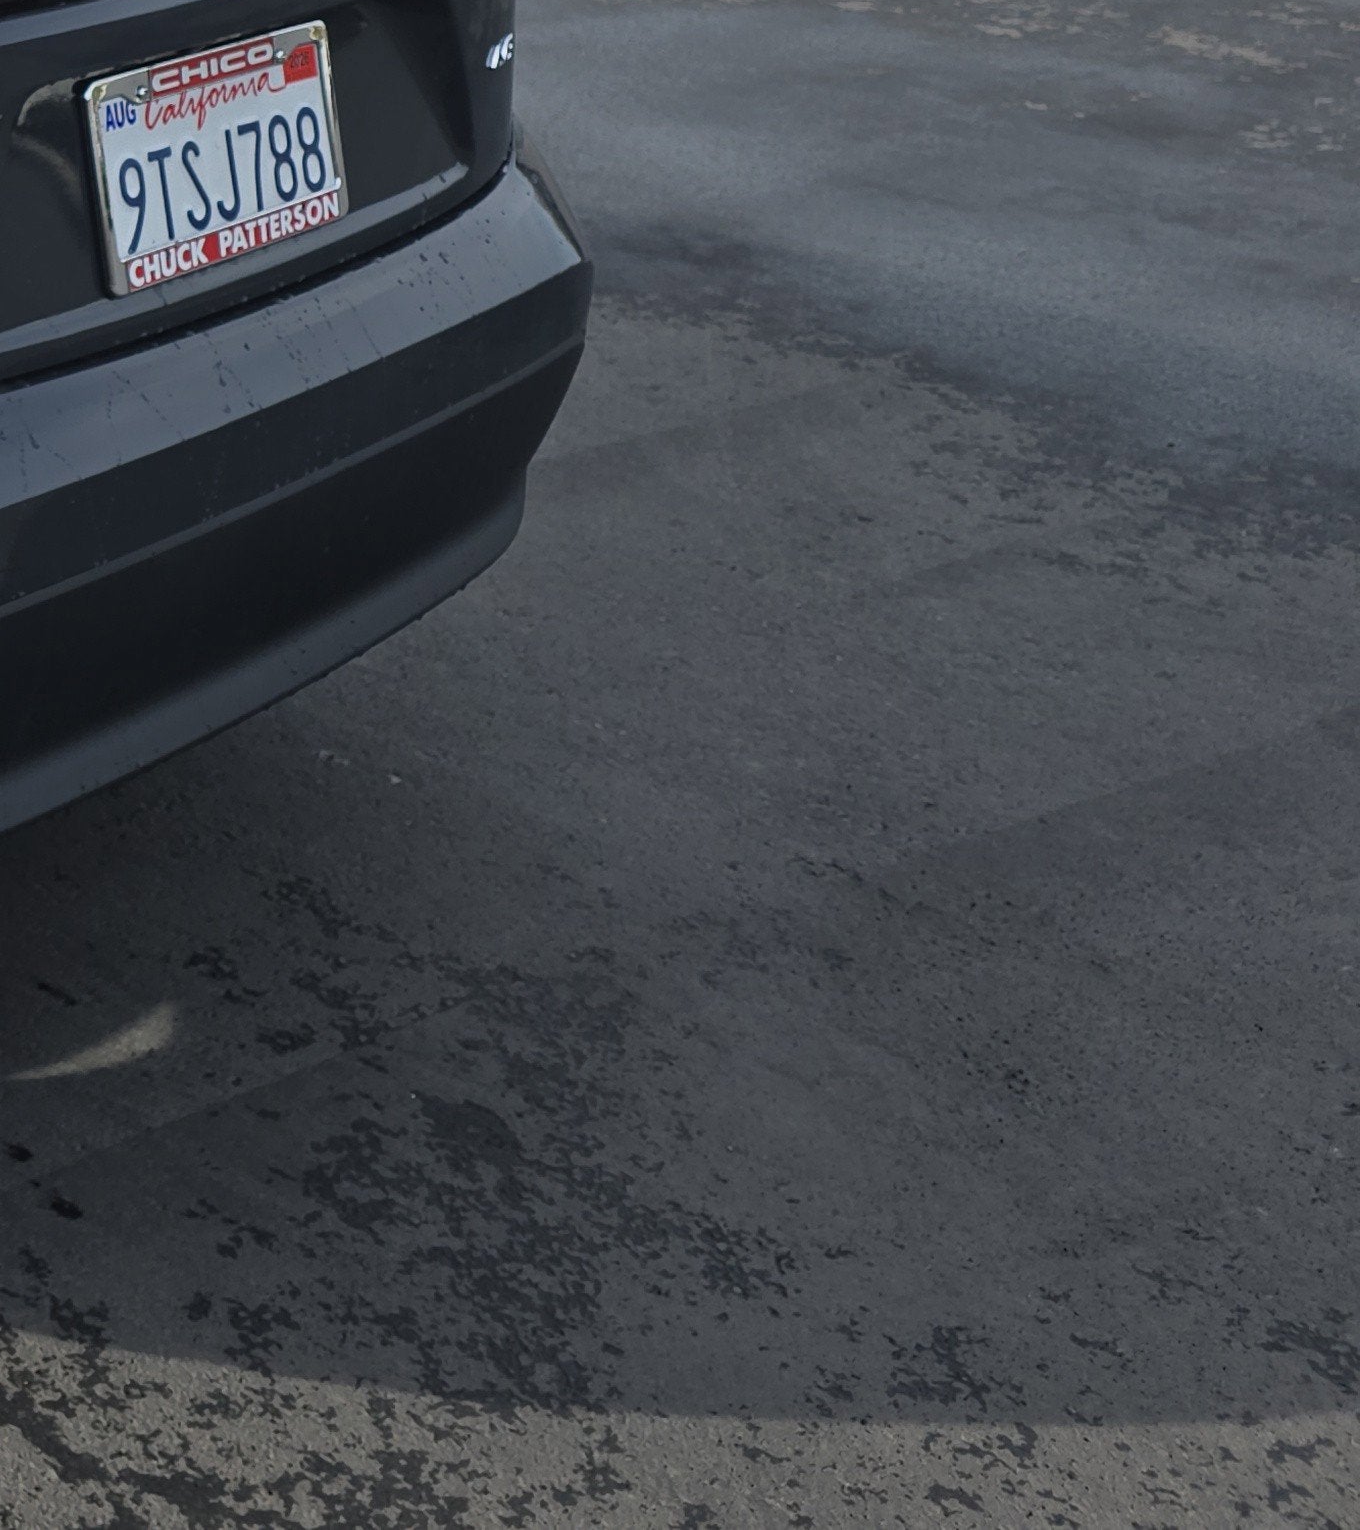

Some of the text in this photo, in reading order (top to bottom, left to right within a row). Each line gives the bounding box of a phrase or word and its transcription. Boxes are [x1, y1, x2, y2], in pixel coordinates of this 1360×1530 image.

[106, 71, 284, 131] AUG California
[152, 43, 273, 92] CHICO
[119, 107, 326, 254] 9TSJ788
[129, 192, 340, 288] CHUCK PATTERSON
